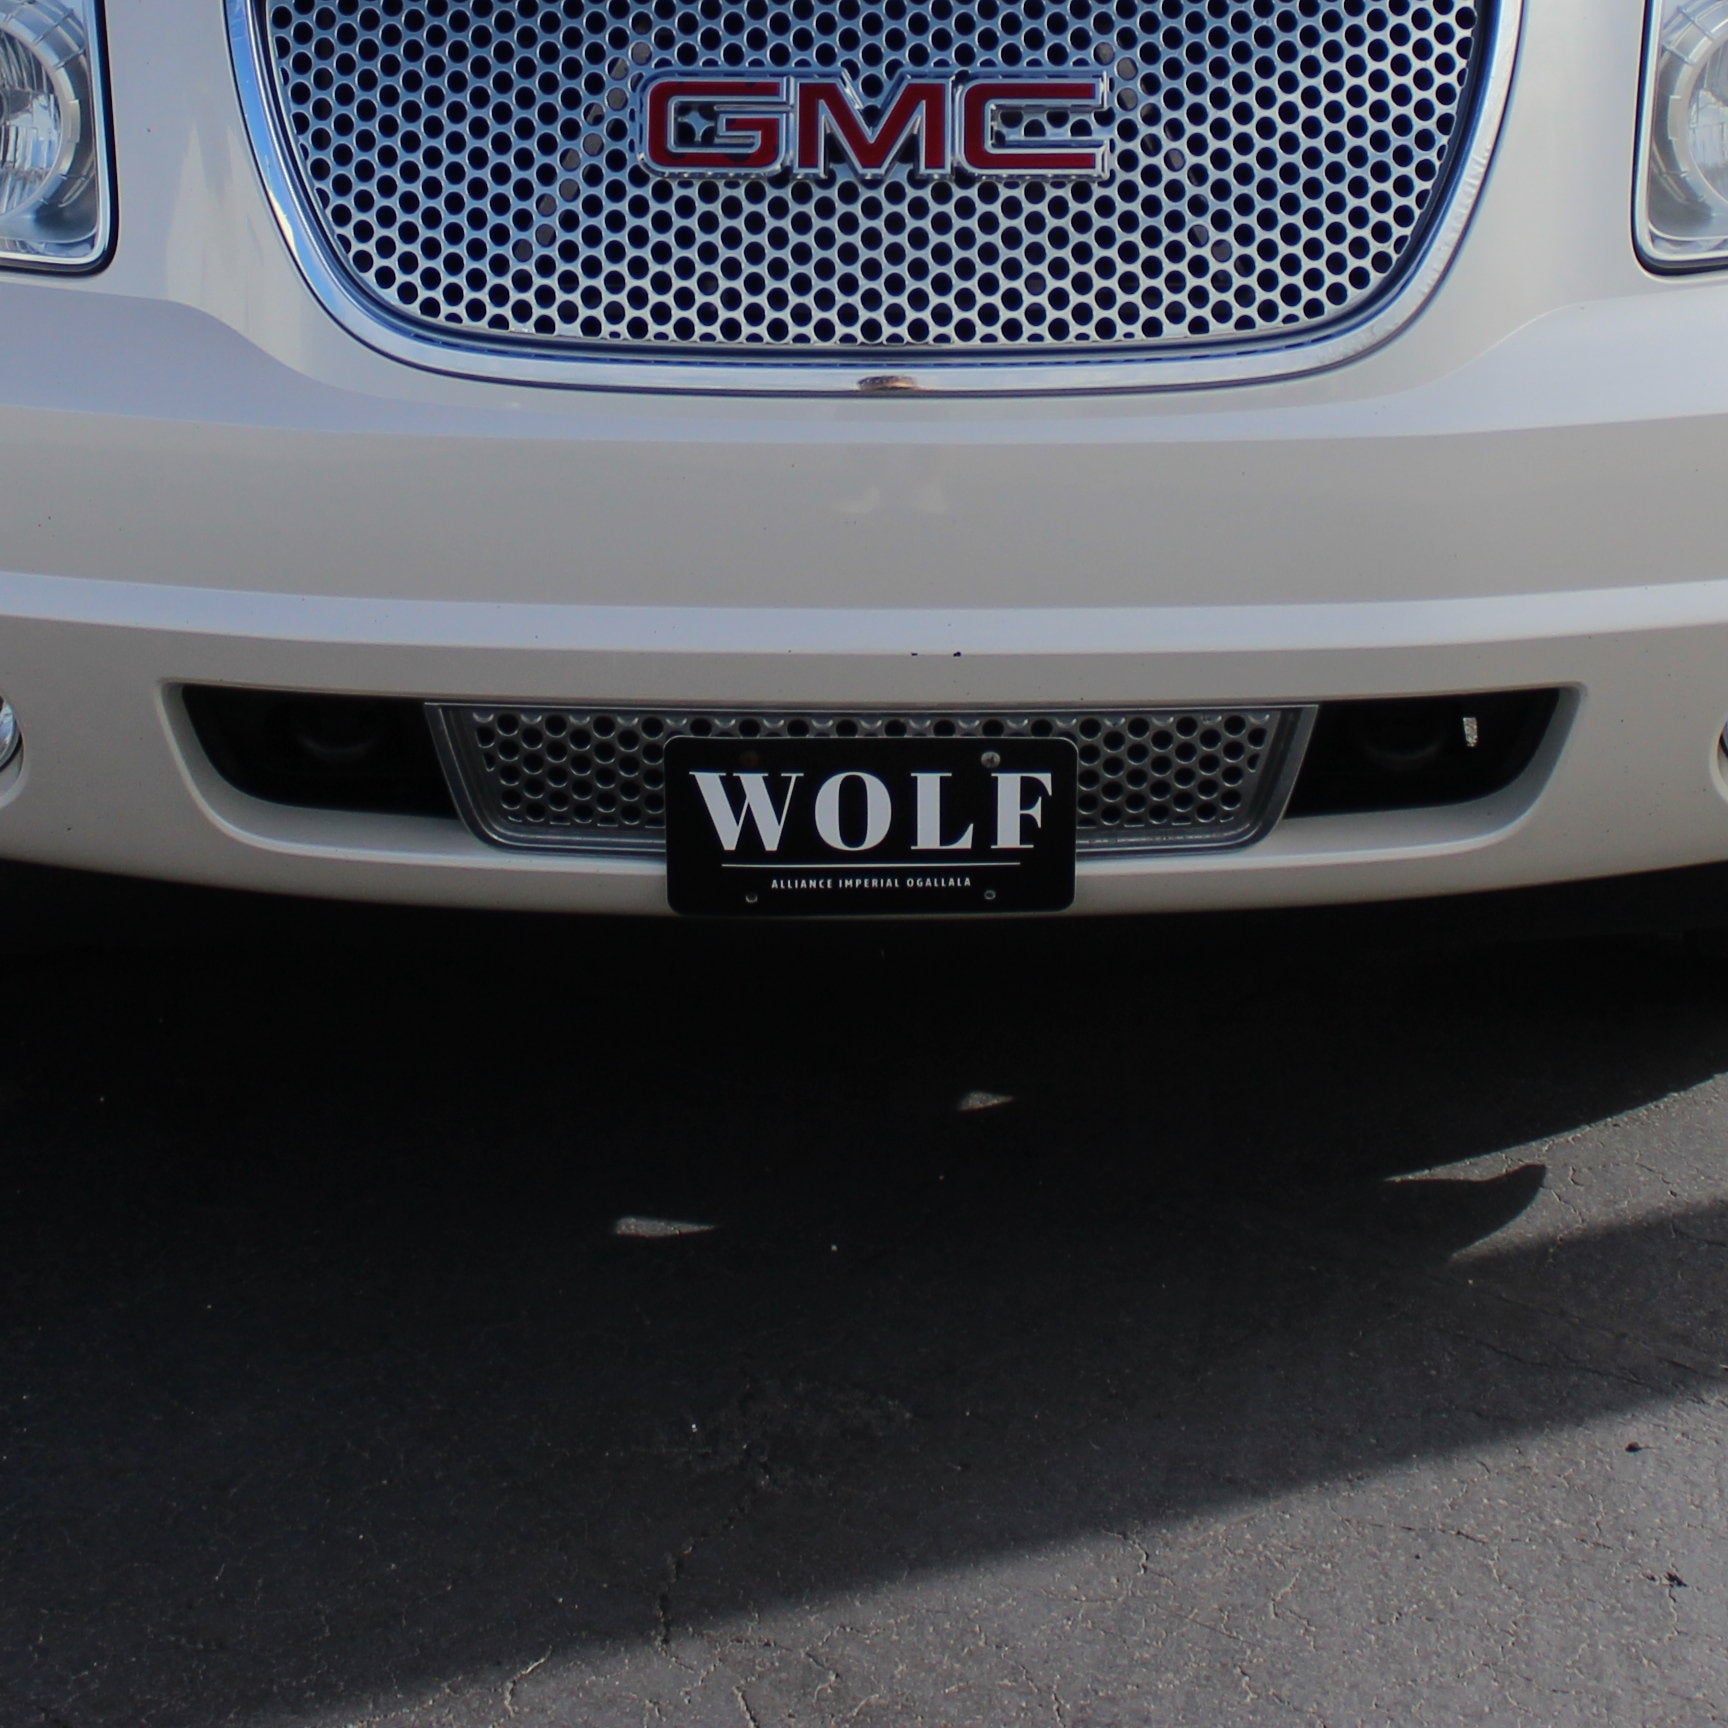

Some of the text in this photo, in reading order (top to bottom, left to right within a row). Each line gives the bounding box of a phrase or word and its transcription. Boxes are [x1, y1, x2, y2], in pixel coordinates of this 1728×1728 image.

[638, 67, 1110, 180] GMC
[688, 770, 1053, 851] WOLF
[771, 877, 972, 889] ALLIANCE IMPERIAL OGALLALA
